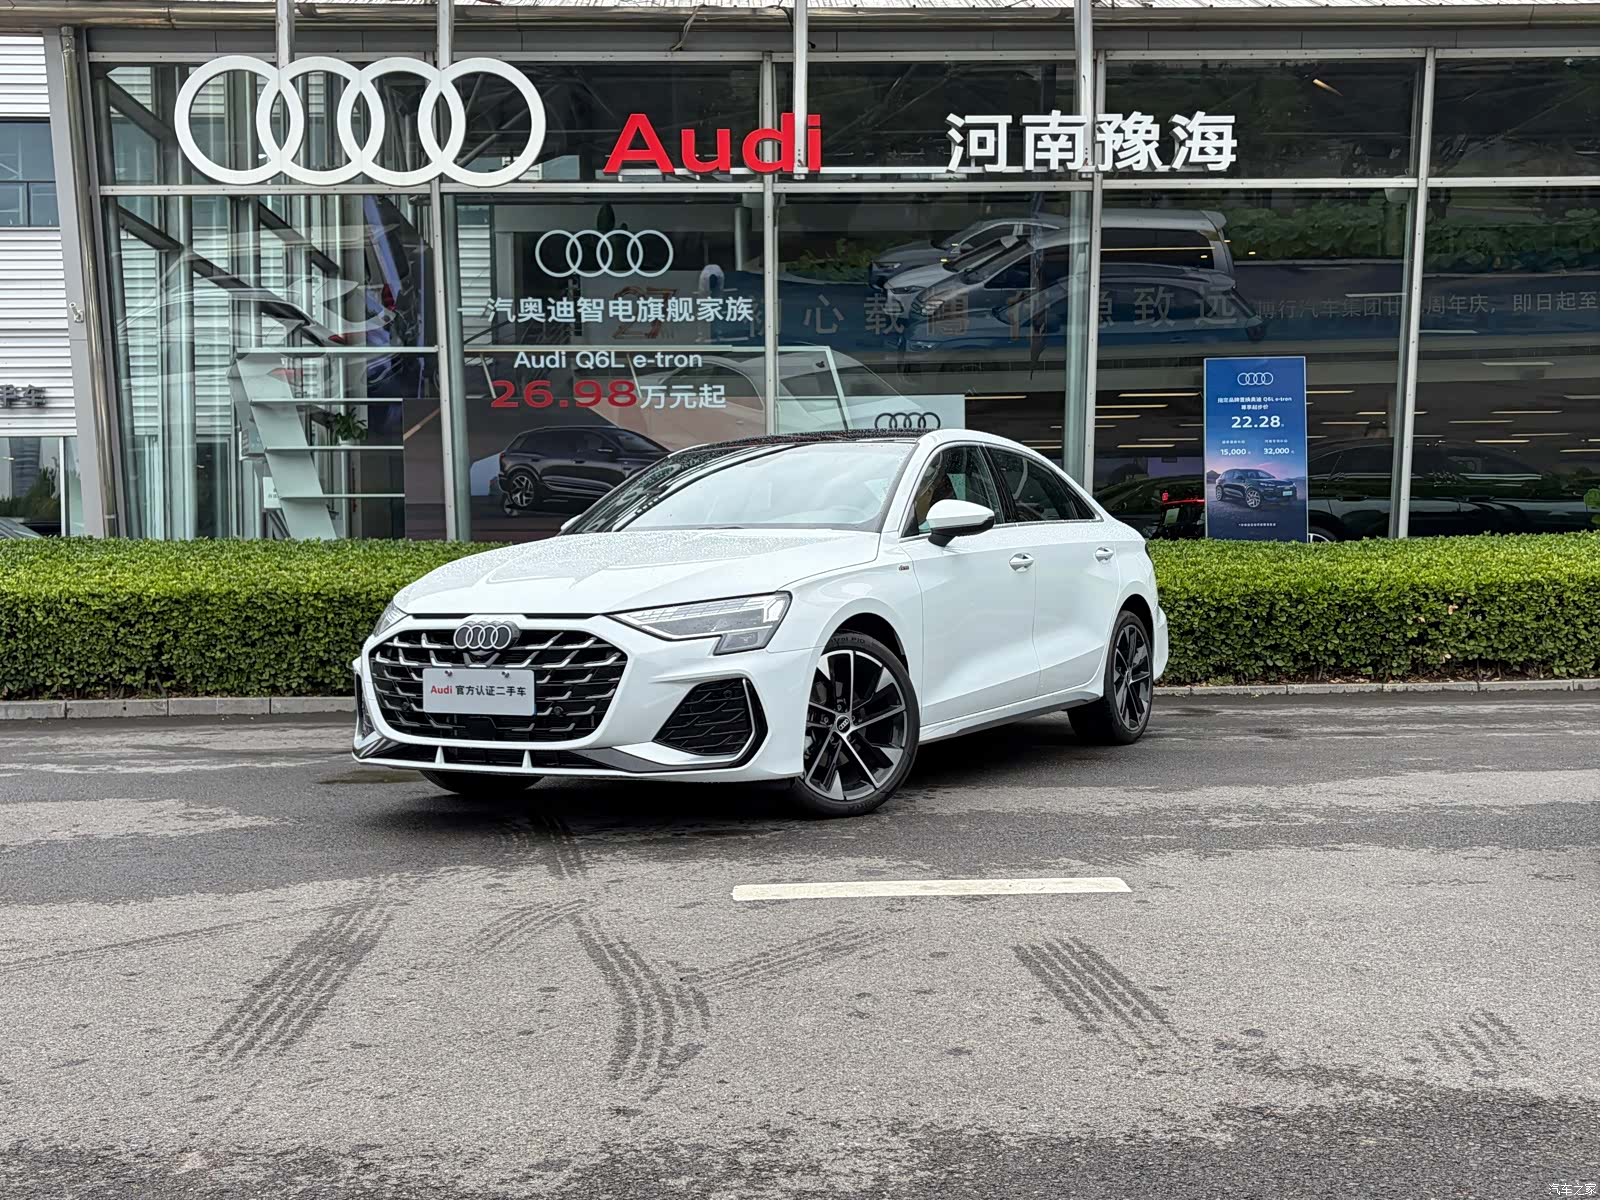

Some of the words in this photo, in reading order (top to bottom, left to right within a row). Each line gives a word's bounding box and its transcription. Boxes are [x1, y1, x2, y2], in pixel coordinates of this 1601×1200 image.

[603, 113, 822, 174] Audi
[945, 109, 1238, 172] 河南豫海
[457, 296, 753, 323] 一汽奥迪智电旗舰家族
[513, 351, 566, 369] Audi
[575, 351, 625, 370] Q6L
[632, 351, 703, 369] e-tron
[490, 380, 727, 410] 26.98万元起
[1231, 416, 1280, 428] 22.28
[1220, 448, 1246, 456] 15,000
[1263, 447, 1289, 455] 32,000
[431, 685, 453, 695] Audi
[455, 685, 527, 697] 官方认证二手车
